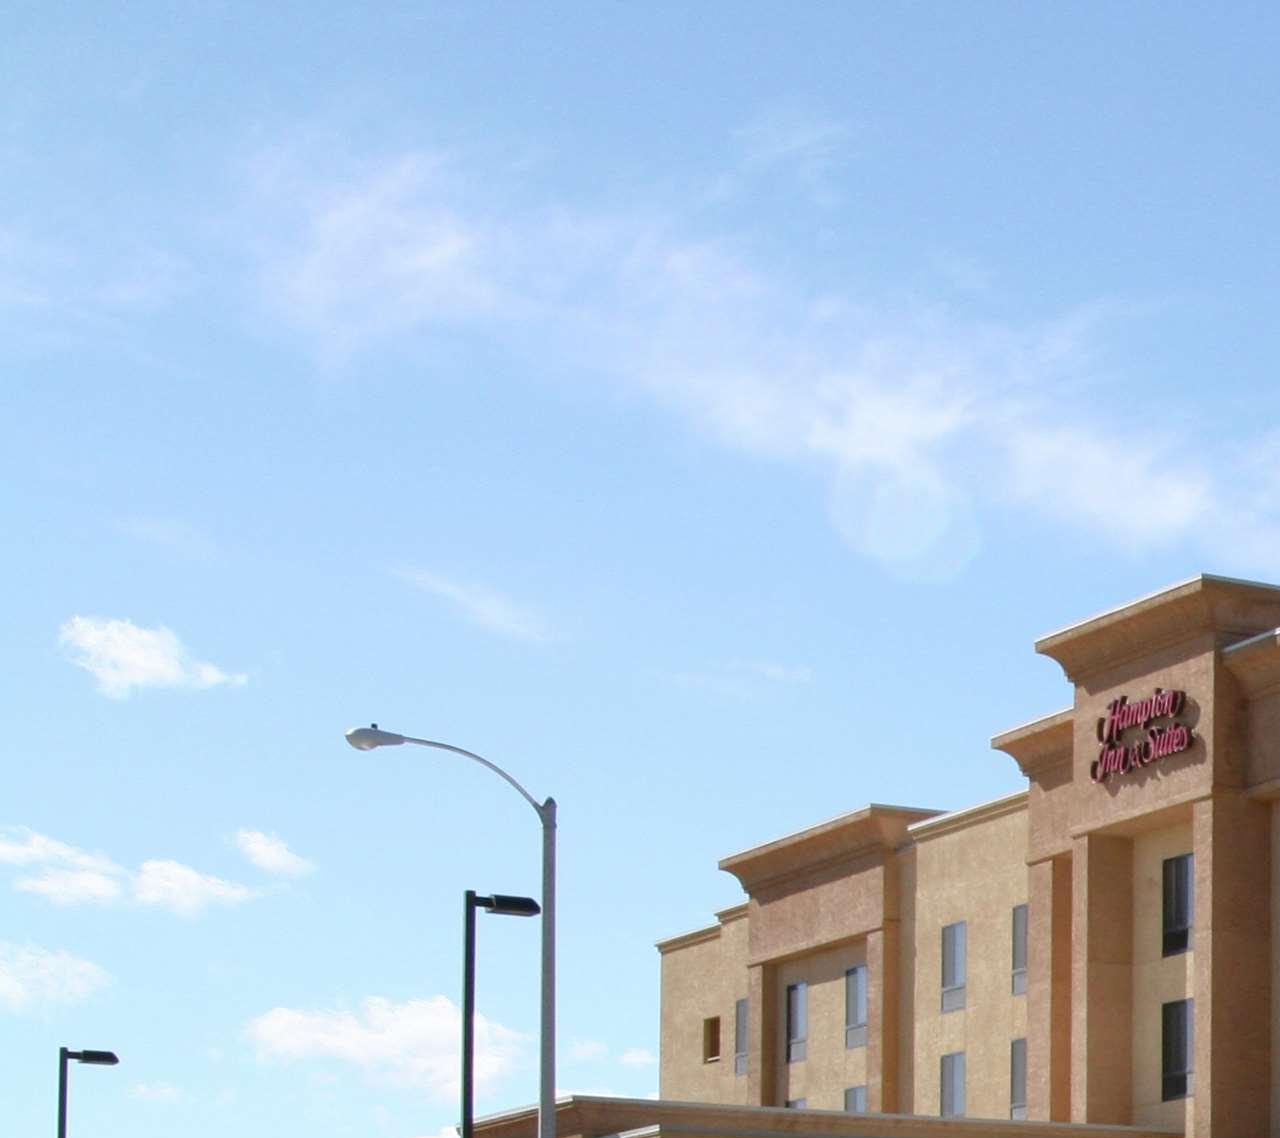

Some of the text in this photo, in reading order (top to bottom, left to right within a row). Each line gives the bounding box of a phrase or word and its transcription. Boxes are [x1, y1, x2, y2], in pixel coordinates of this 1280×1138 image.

[1100, 688, 1185, 743] Hampton
[1091, 744, 1131, 783] Inn
[1143, 724, 1193, 762] Suites
